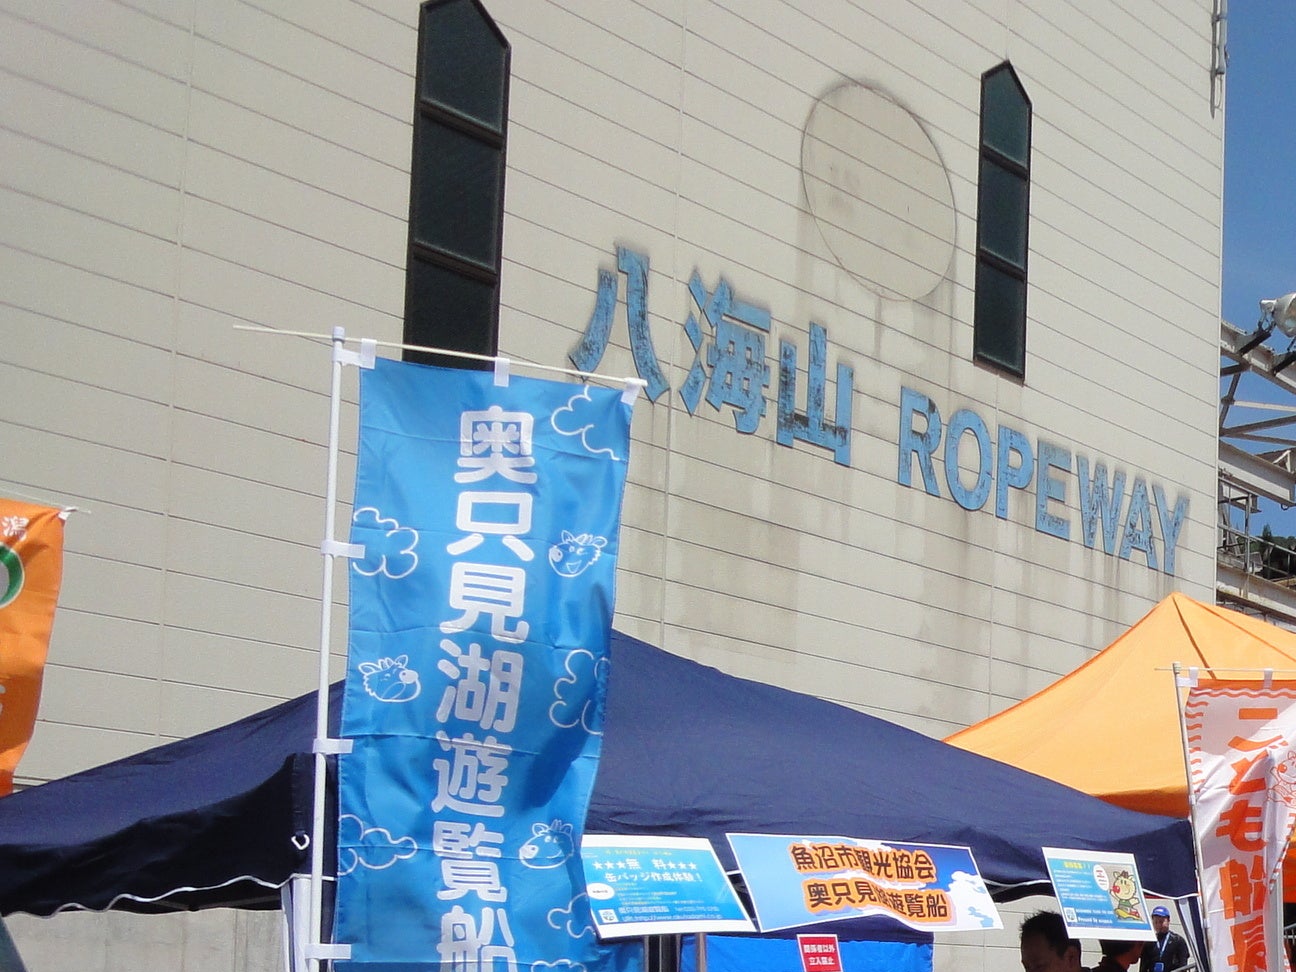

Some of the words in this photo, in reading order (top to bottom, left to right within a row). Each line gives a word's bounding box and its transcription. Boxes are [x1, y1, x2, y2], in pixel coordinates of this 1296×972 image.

[567, 244, 853, 467] 八海山
[899, 384, 1190, 577] ROPEWAY
[791, 845, 935, 882] 魚沼市観光協会
[807, 881, 948, 918] 奥只見湖遊覧船
[809, 957, 834, 966] 立入禁止
